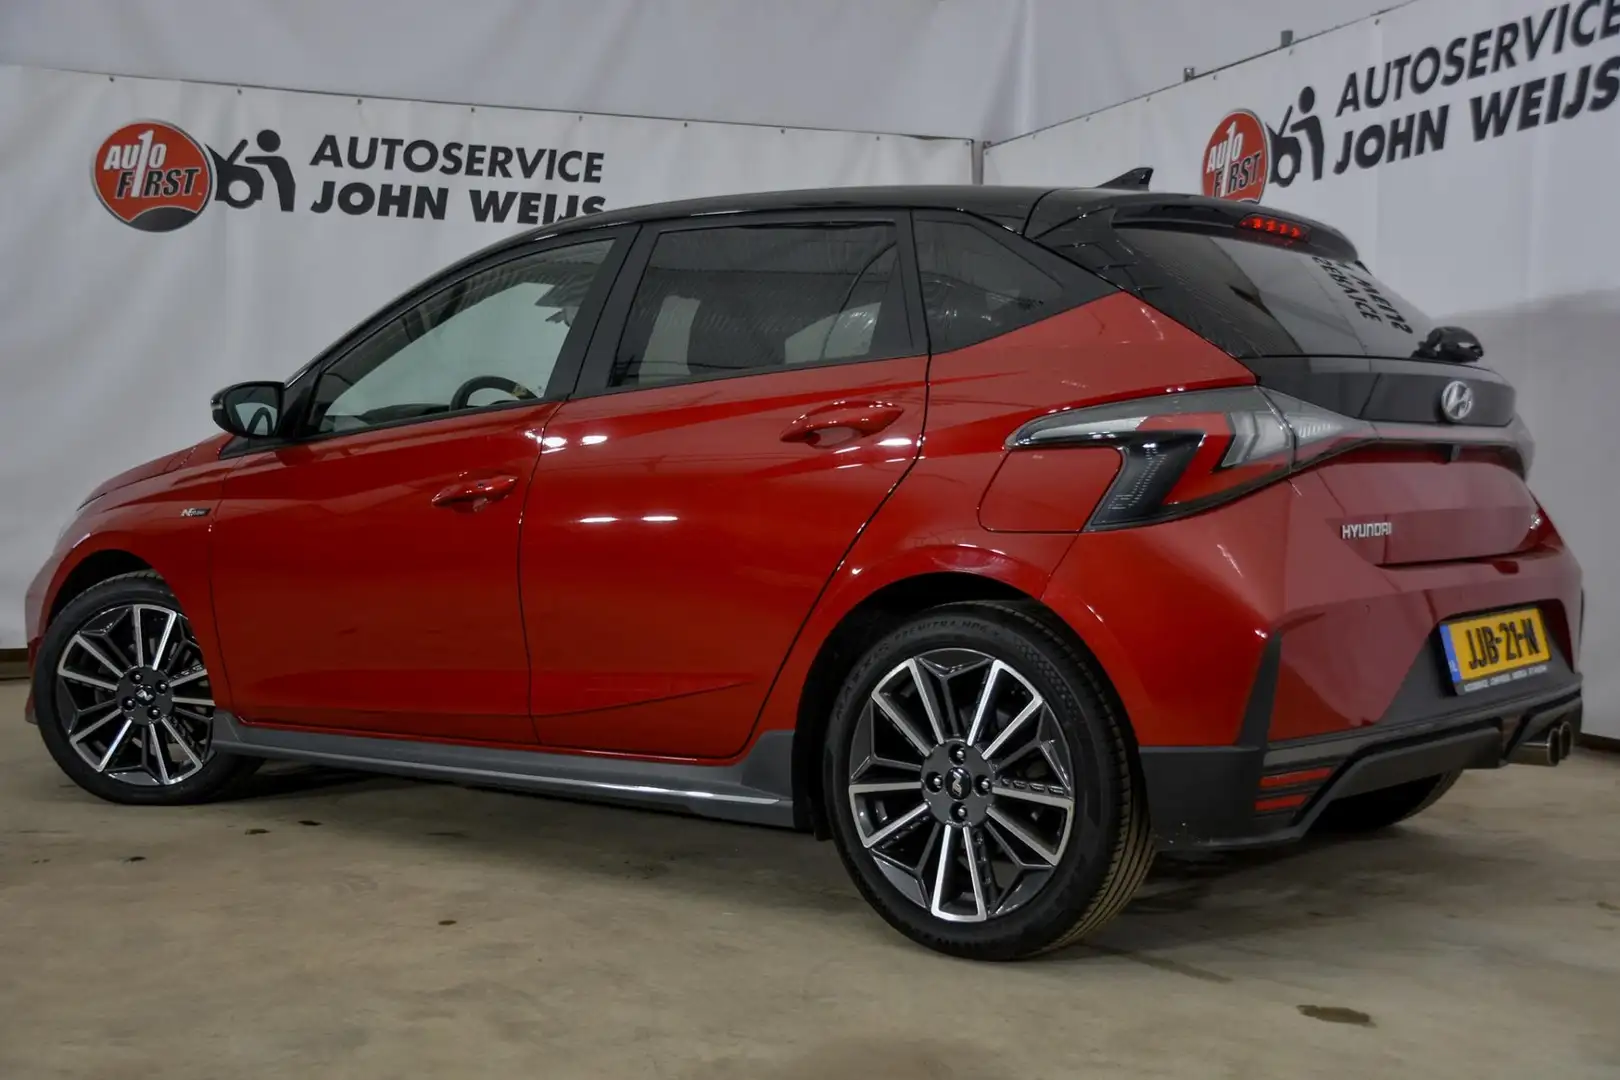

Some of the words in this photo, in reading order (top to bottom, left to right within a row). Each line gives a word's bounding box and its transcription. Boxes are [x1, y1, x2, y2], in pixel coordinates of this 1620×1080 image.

[1335, 0, 1620, 117] AUTOSERVICE
[1333, 104, 1450, 175] JOHN
[1470, 55, 1620, 142] WEIJS
[309, 134, 605, 184] AUTOSERVICE
[310, 180, 449, 221] JOHN
[468, 189, 606, 225] WEIJS
[1341, 521, 1393, 540] HYUNDAI
[1465, 616, 1541, 671] JJB-21-N
